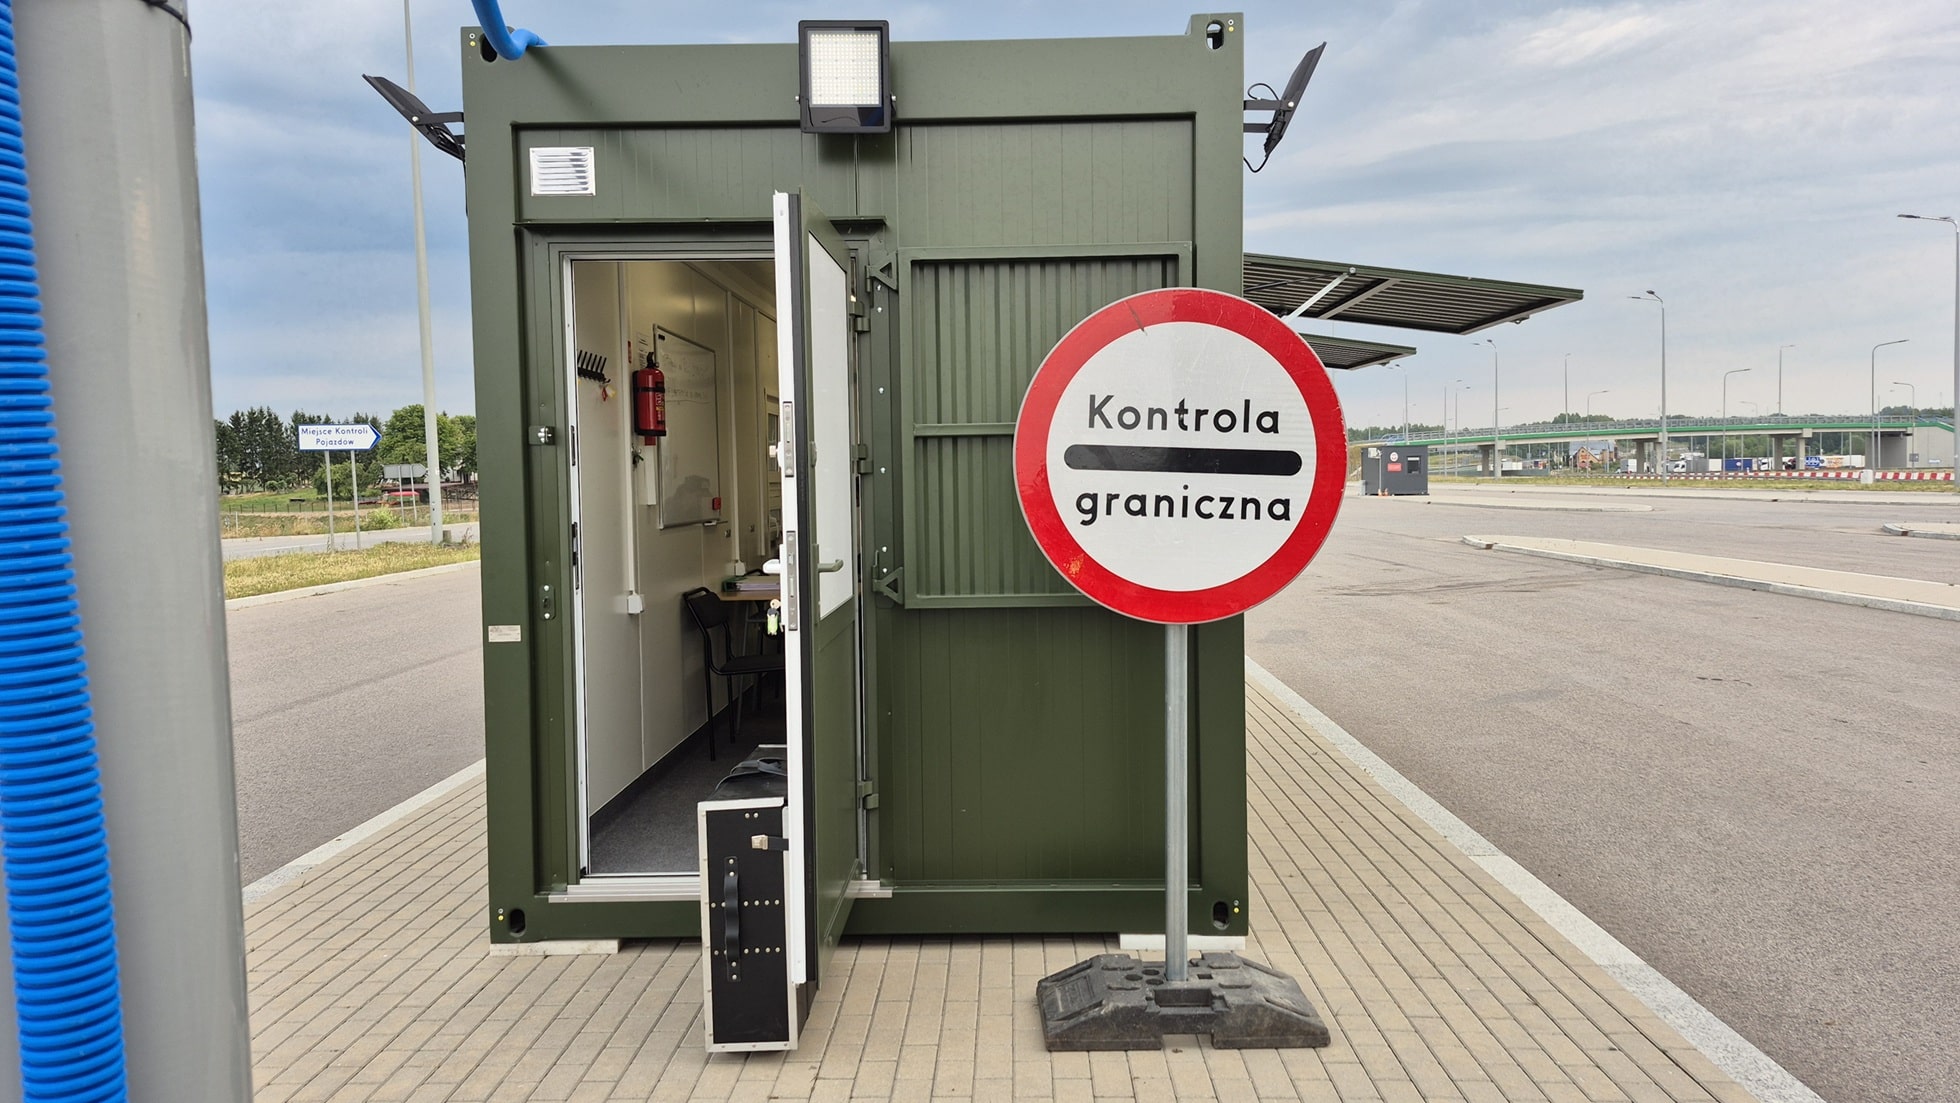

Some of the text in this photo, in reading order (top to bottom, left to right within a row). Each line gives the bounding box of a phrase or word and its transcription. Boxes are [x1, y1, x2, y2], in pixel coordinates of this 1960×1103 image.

[301, 427, 368, 436] Miejsce Kontroli
[1088, 394, 1279, 434] Kontrola
[1075, 484, 1291, 526] graniczna
